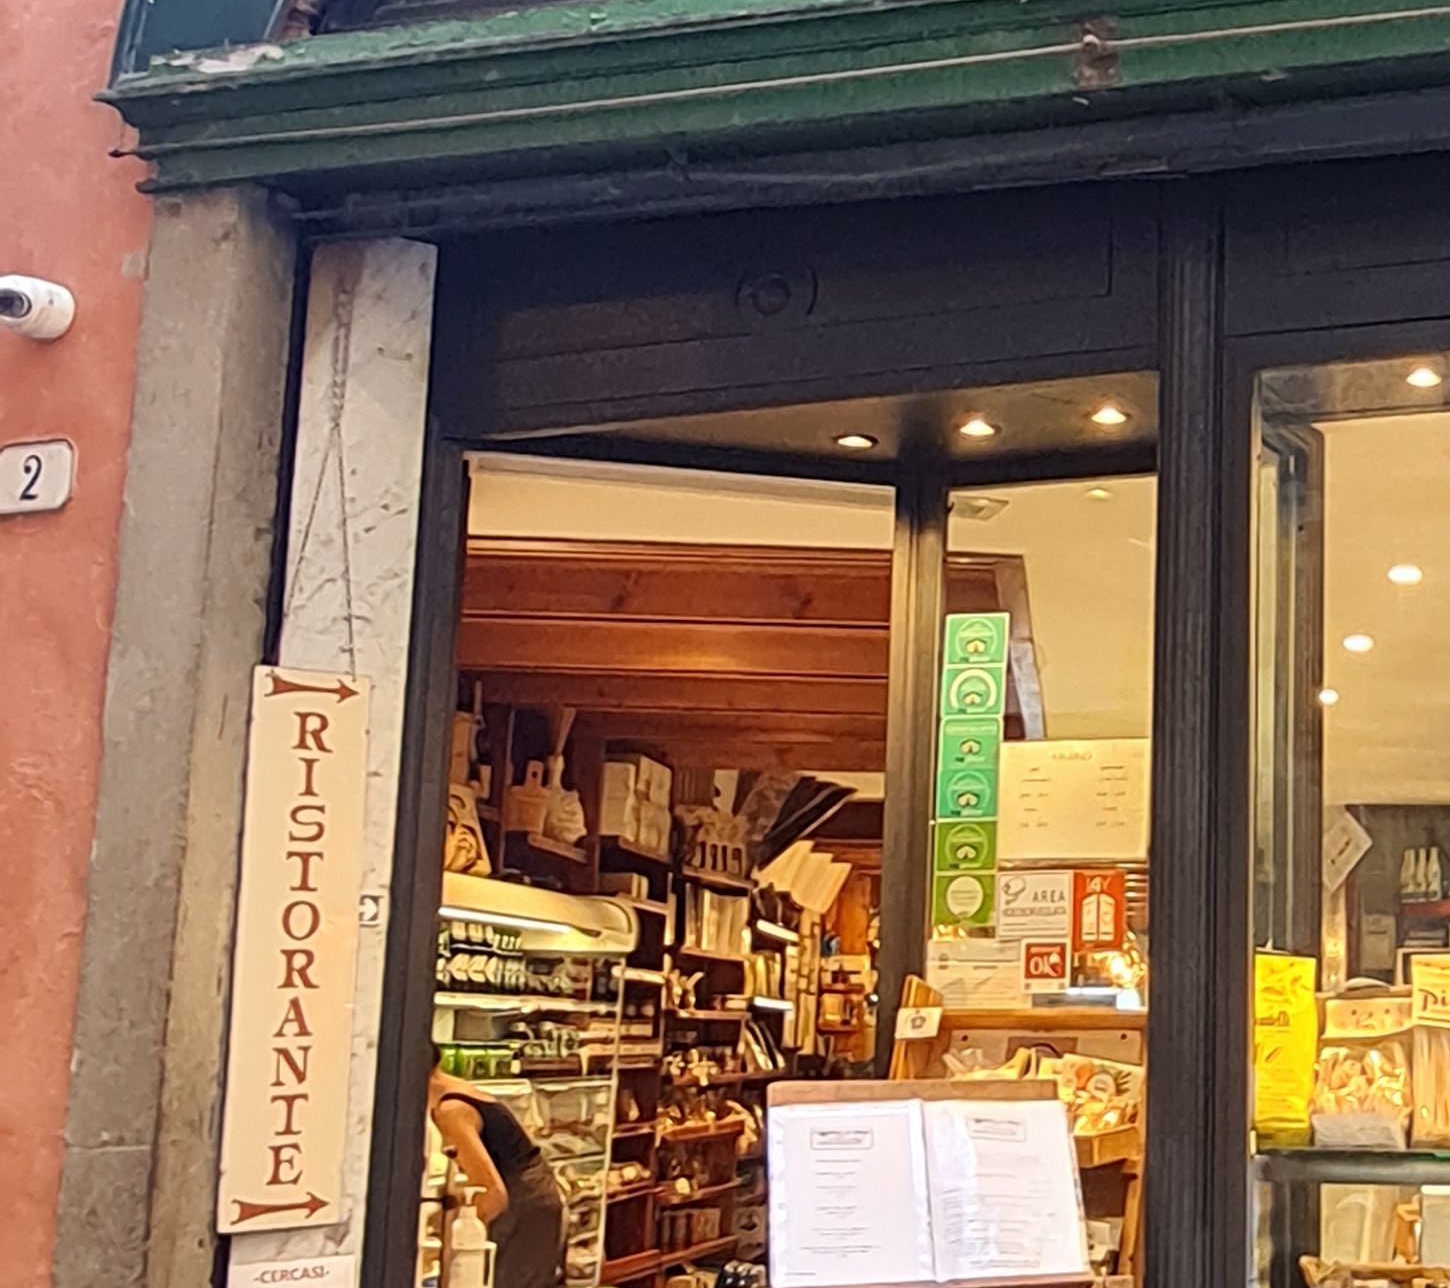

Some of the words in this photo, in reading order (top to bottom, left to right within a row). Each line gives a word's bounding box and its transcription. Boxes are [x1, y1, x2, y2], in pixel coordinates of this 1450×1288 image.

[19, 455, 42, 501] 2
[1032, 890, 1066, 903] AREA
[265, 710, 333, 1187] RISTORANTE
